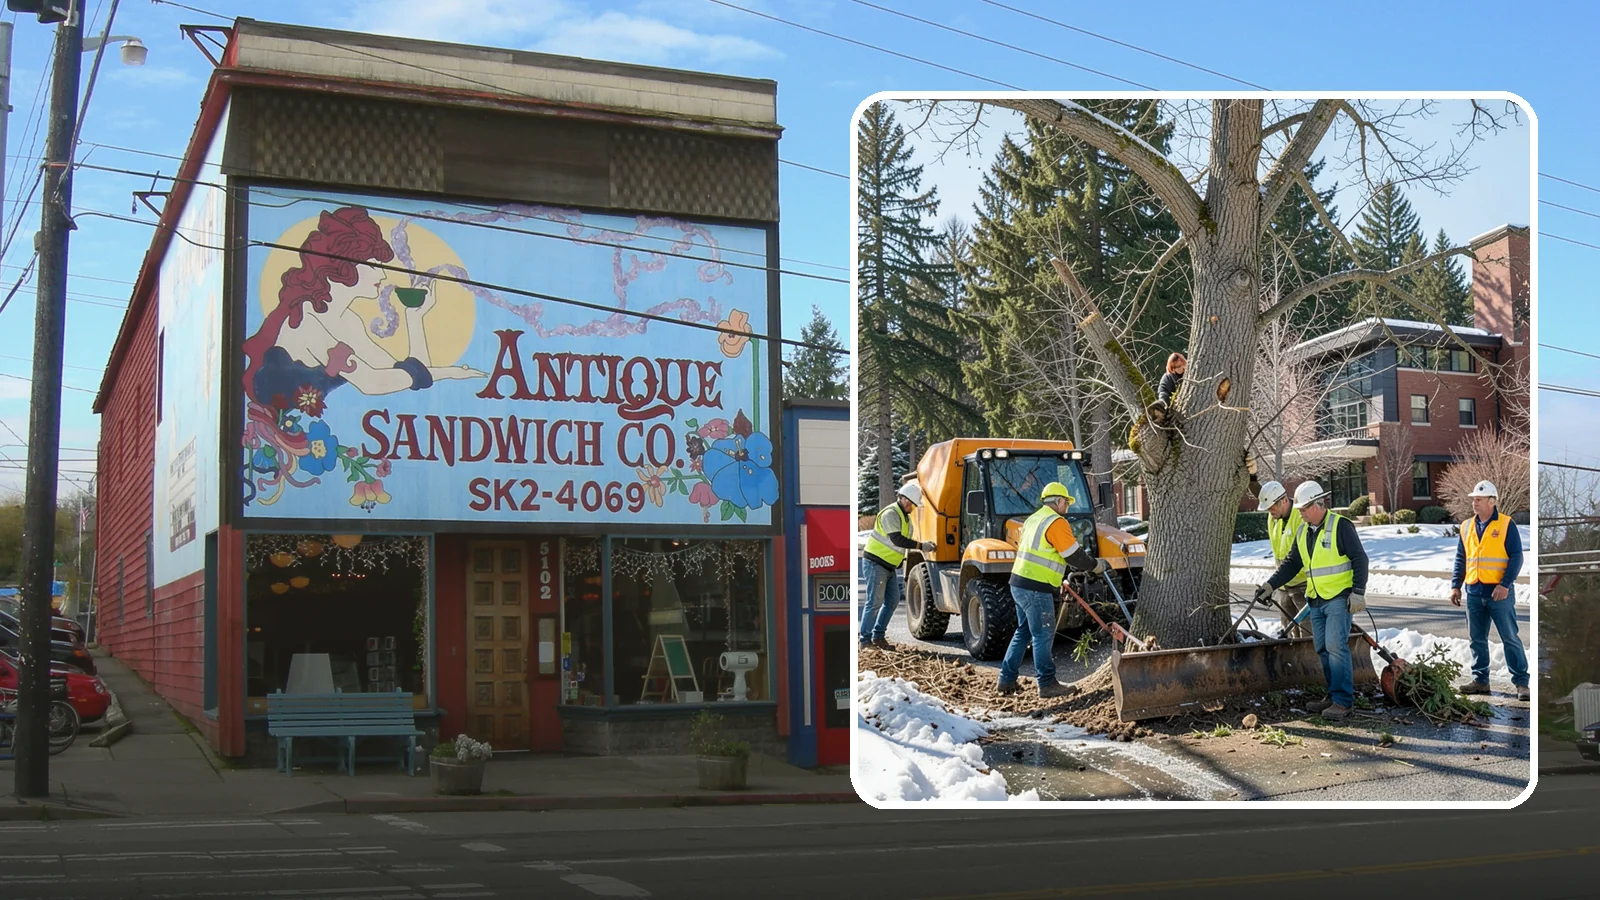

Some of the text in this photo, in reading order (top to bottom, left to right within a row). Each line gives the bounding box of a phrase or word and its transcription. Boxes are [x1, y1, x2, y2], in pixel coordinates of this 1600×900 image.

[476, 329, 723, 420] ANTIQUE
[361, 408, 685, 469] SANDWICH CO.
[468, 477, 646, 513] SK2-4069
[540, 541, 551, 599] 5102
[809, 555, 834, 569] BOOKS
